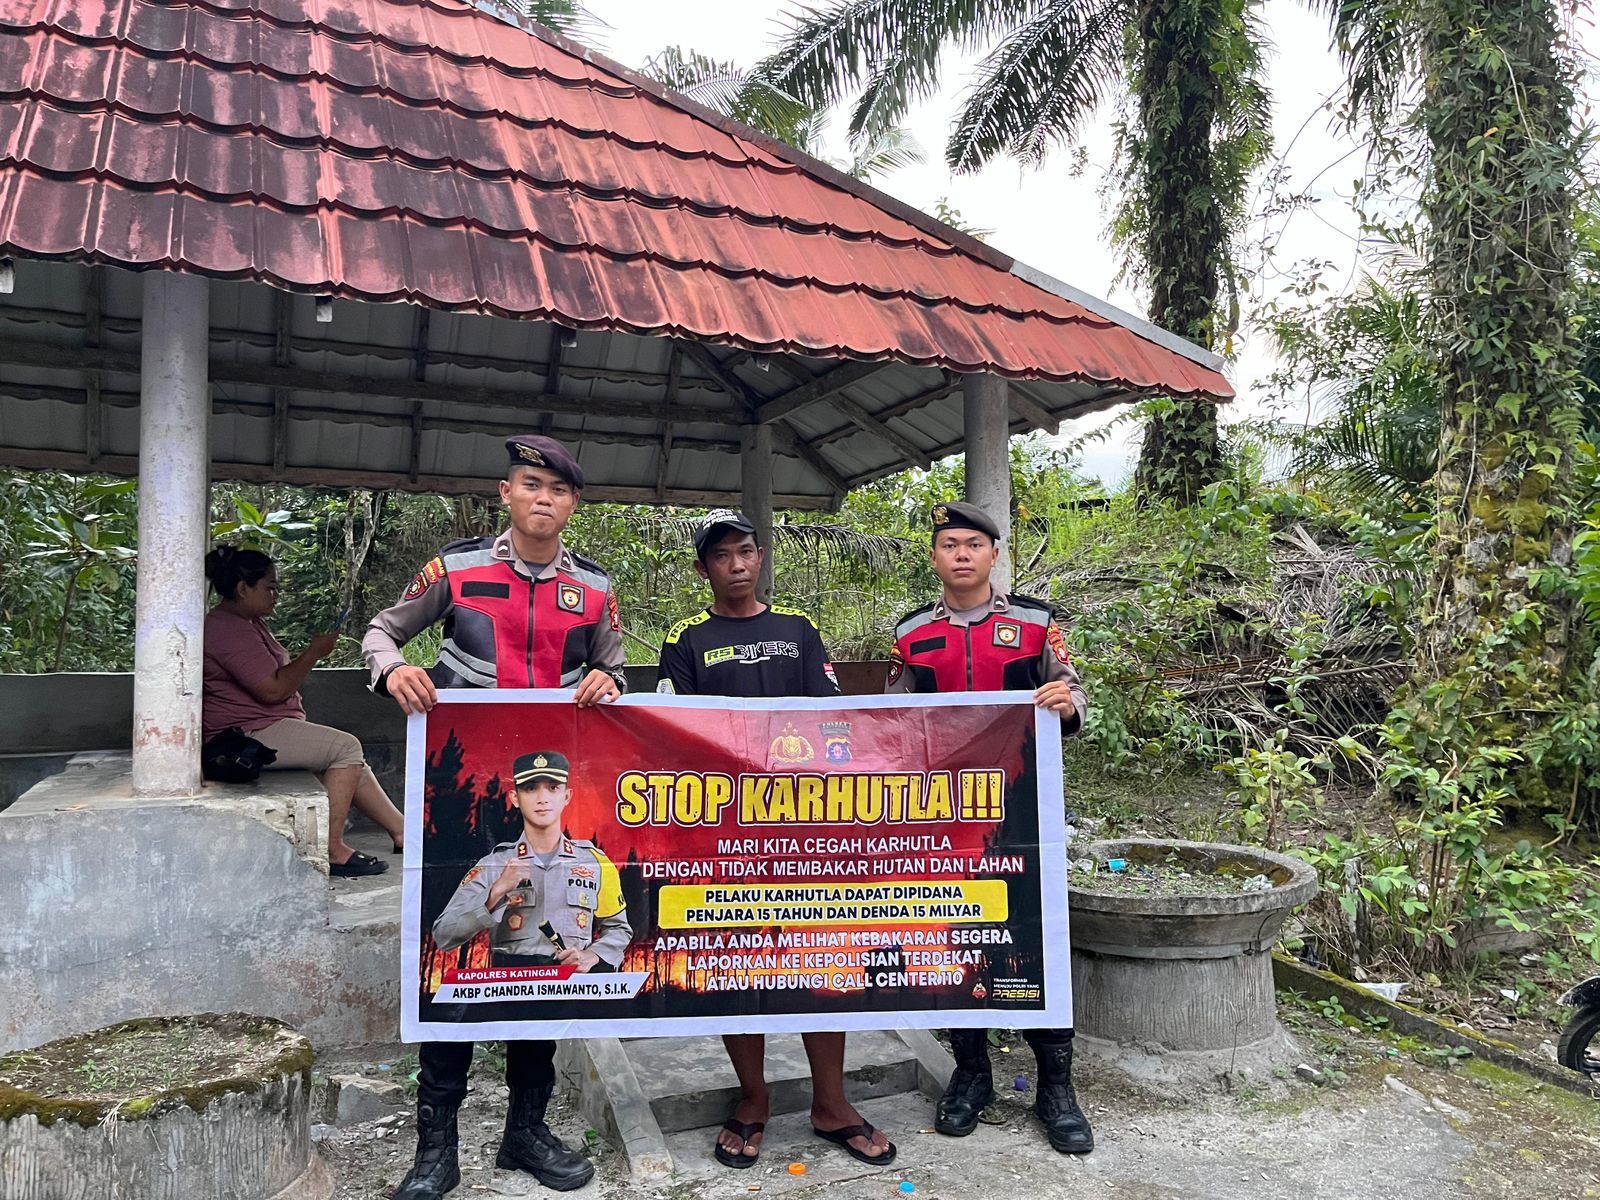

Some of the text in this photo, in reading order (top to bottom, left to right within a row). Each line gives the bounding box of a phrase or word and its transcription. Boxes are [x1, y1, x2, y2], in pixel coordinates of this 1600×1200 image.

[616, 769, 1005, 827] STOP KARHUTLA !!!
[718, 835, 952, 854] MARI KITA CEGAH KARHUTLA
[643, 857, 1024, 878] DENGAN TIDAK MEMBAKAR HUTAN DAN LAHAN
[568, 878, 597, 890] POLRI
[706, 886, 963, 903] PELAKU KARHUTLA DAPAT DIPIDANA
[687, 904, 981, 922] PENJARA 15 TAHUN DAN DENDA 15 MILYAR
[655, 929, 1013, 951] APABILA ANDA MELIHAT KEBAKARAN SEGERA
[687, 950, 982, 971] LAPORKAN KE KEPOLISIAN TERDEKAT
[457, 968, 559, 981] KAPOLRES KATINGAN
[706, 975, 750, 991] ATAU
[753, 974, 829, 990] HUBUNGI
[832, 973, 872, 989] CALL
[452, 982, 631, 998] AKBP CHANDRA ISMAWANTO, S.I.K.
[992, 990, 1041, 998] PRESISI
